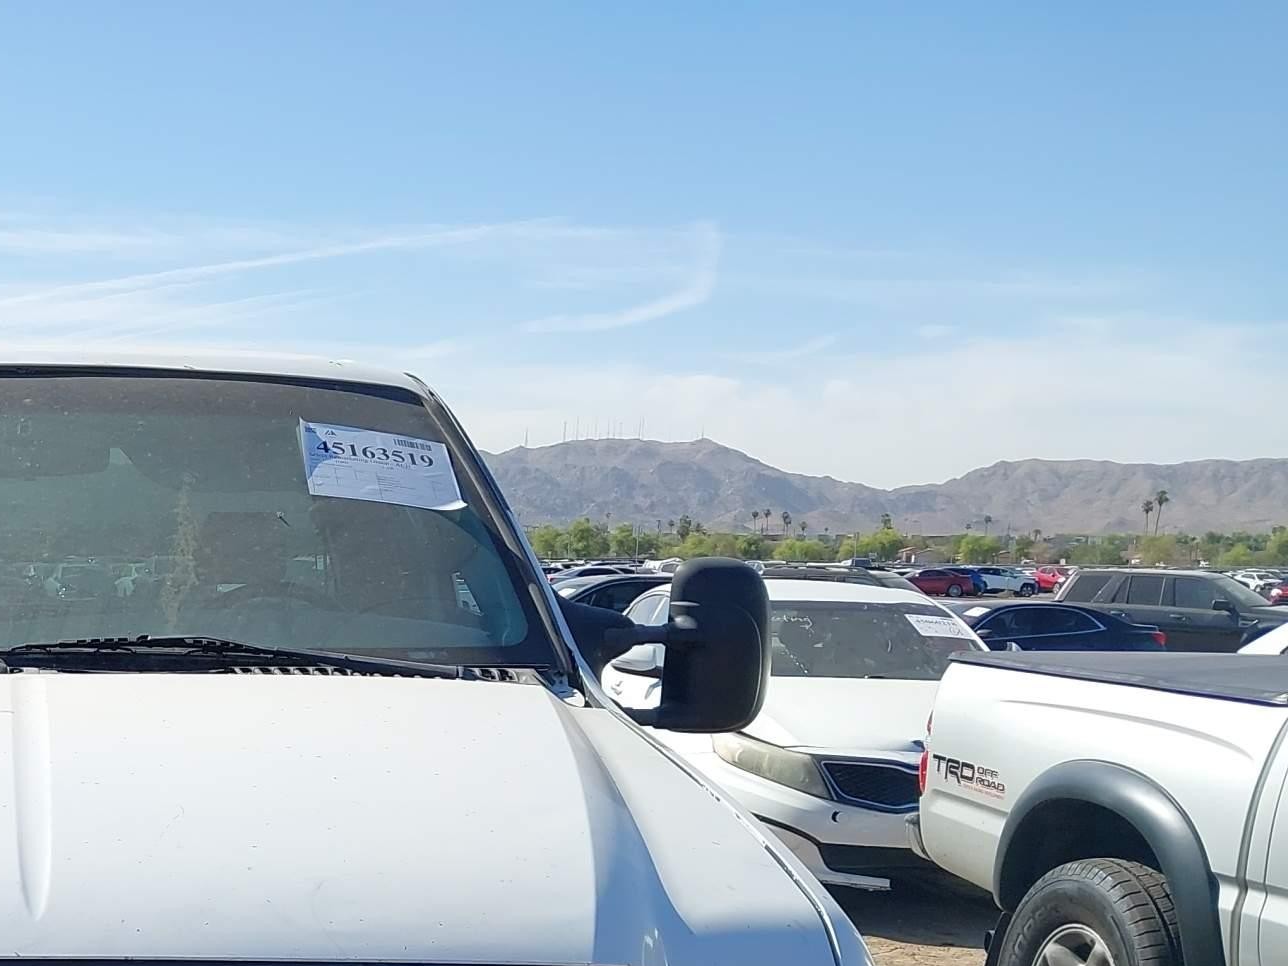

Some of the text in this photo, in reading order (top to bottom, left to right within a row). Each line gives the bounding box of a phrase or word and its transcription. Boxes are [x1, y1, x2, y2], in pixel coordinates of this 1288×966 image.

[316, 440, 434, 468] 45163519
[932, 753, 999, 785] TRD OFF
[975, 776, 1005, 792] ROAD
